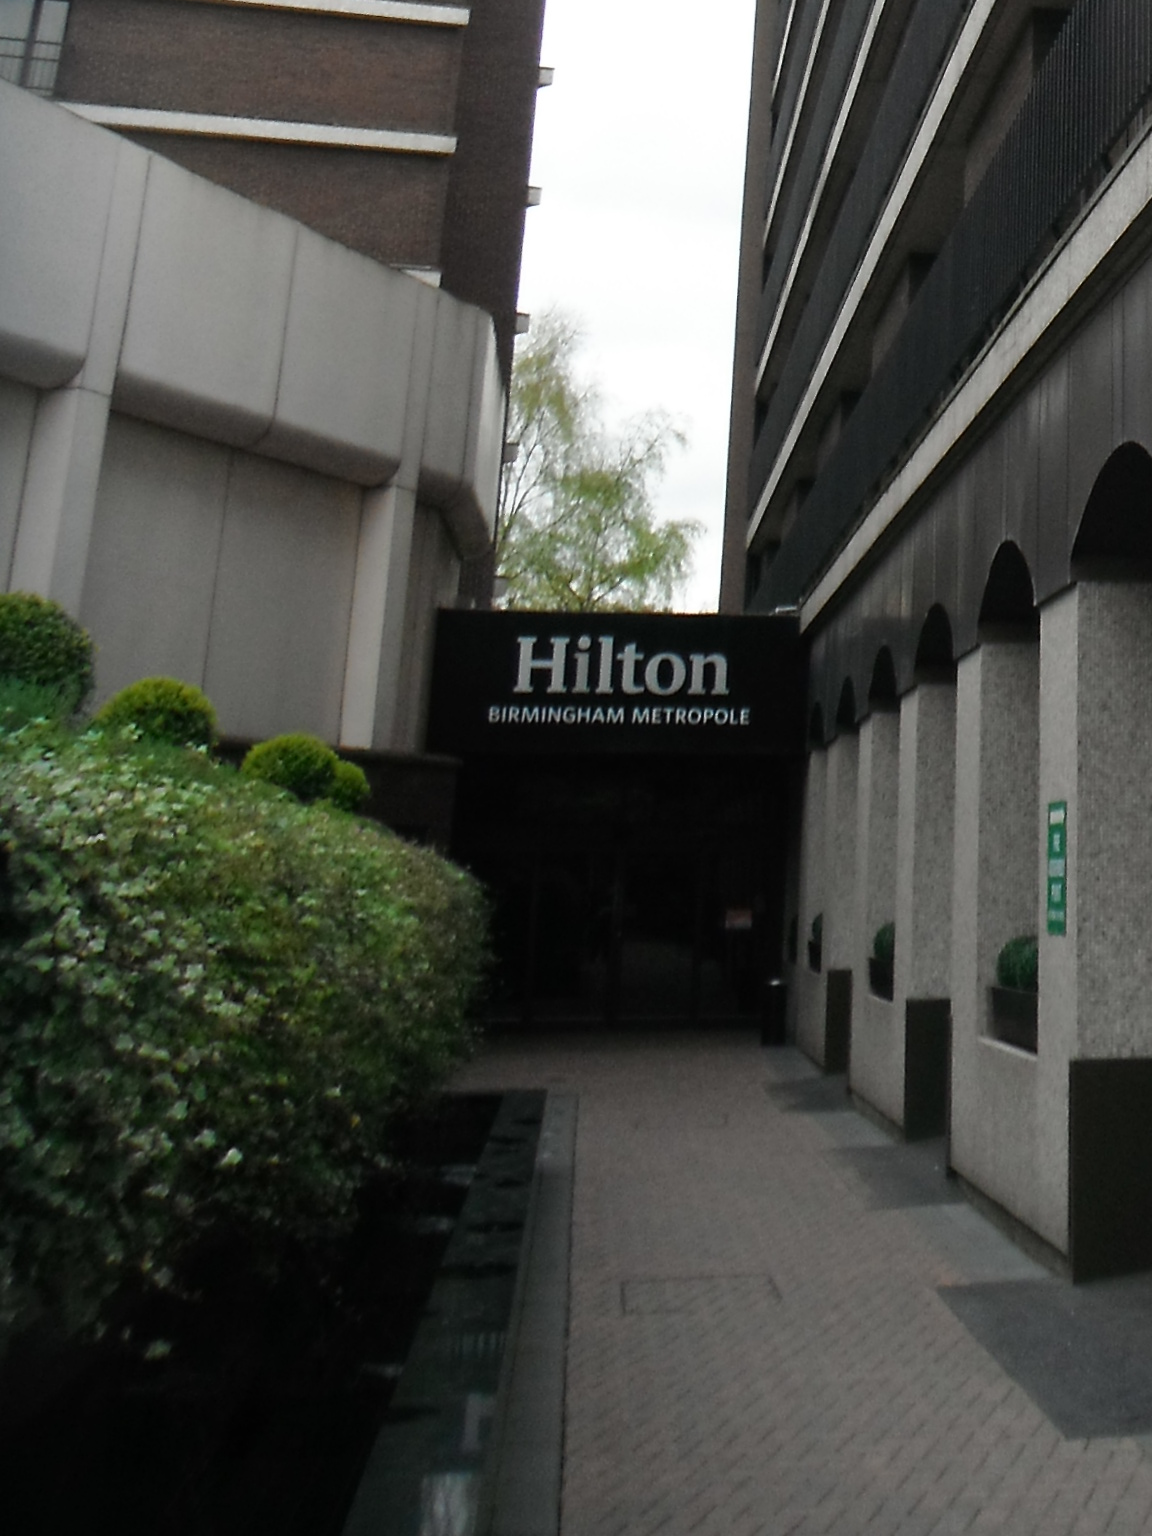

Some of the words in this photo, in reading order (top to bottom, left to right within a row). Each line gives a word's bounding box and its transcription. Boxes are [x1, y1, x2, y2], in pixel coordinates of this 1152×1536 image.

[512, 634, 731, 696] Hilton
[488, 705, 625, 724] BIRMINGHAM
[631, 707, 750, 725] METROPOLE
